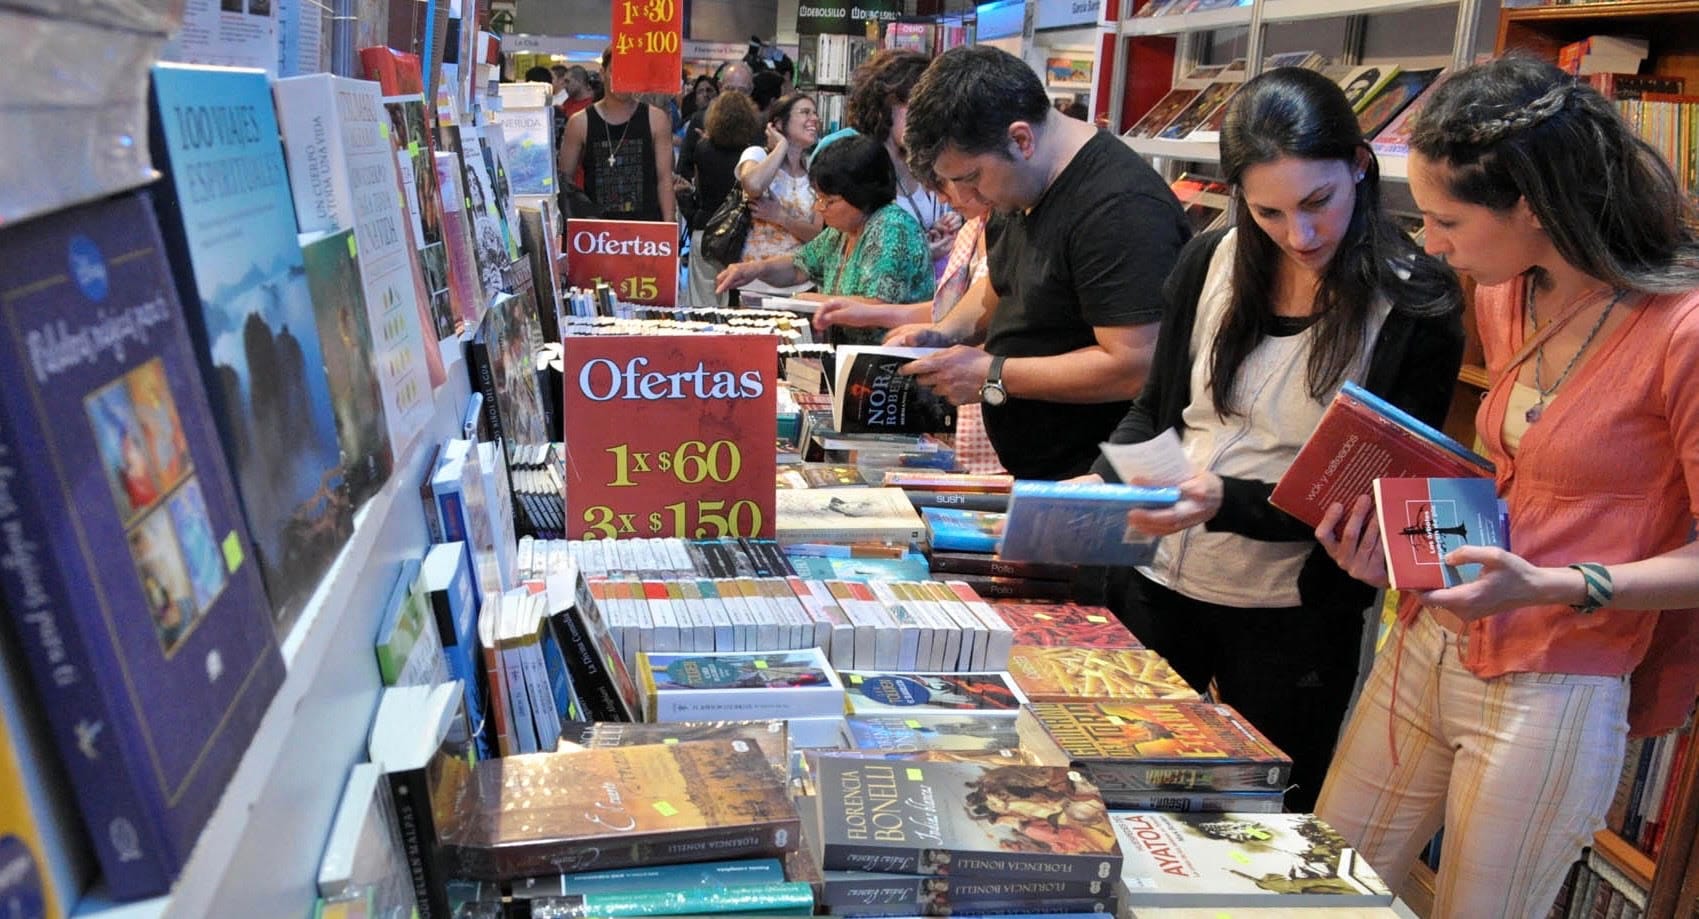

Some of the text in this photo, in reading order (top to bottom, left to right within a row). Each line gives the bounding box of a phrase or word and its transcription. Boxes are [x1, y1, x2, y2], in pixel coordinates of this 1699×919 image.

[623, 0, 674, 25] 1x $30
[807, 7, 846, 18] DEBOLSILLO
[616, 31, 678, 55] 4x $100
[174, 104, 261, 150] 100 VIAJES
[312, 115, 326, 142] VIDA
[503, 118, 542, 128] NERUDA
[305, 144, 322, 197] CUERPO
[573, 231, 671, 257] Ofertas
[620, 277, 658, 300] $15
[479, 364, 491, 386] AGUA
[579, 357, 764, 402] Ofertas
[868, 362, 898, 425] NORA
[607, 440, 741, 487] 1x $60
[936, 494, 965, 504] sushi
[584, 499, 762, 540] 3x $150
[991, 563, 1015, 575] Pollo
[990, 584, 1013, 595] Pollo
[841, 771, 868, 841] FLORENCIA
[864, 765, 905, 842] BONELLI
[401, 804, 420, 856] MALPAS
[708, 837, 760, 850] FLORENCIA
[1125, 815, 1191, 877] AYATOLA
[957, 858, 1073, 874] FLORENCIA BONELLI
[955, 883, 1067, 898] FLORENCIA BONELLI
